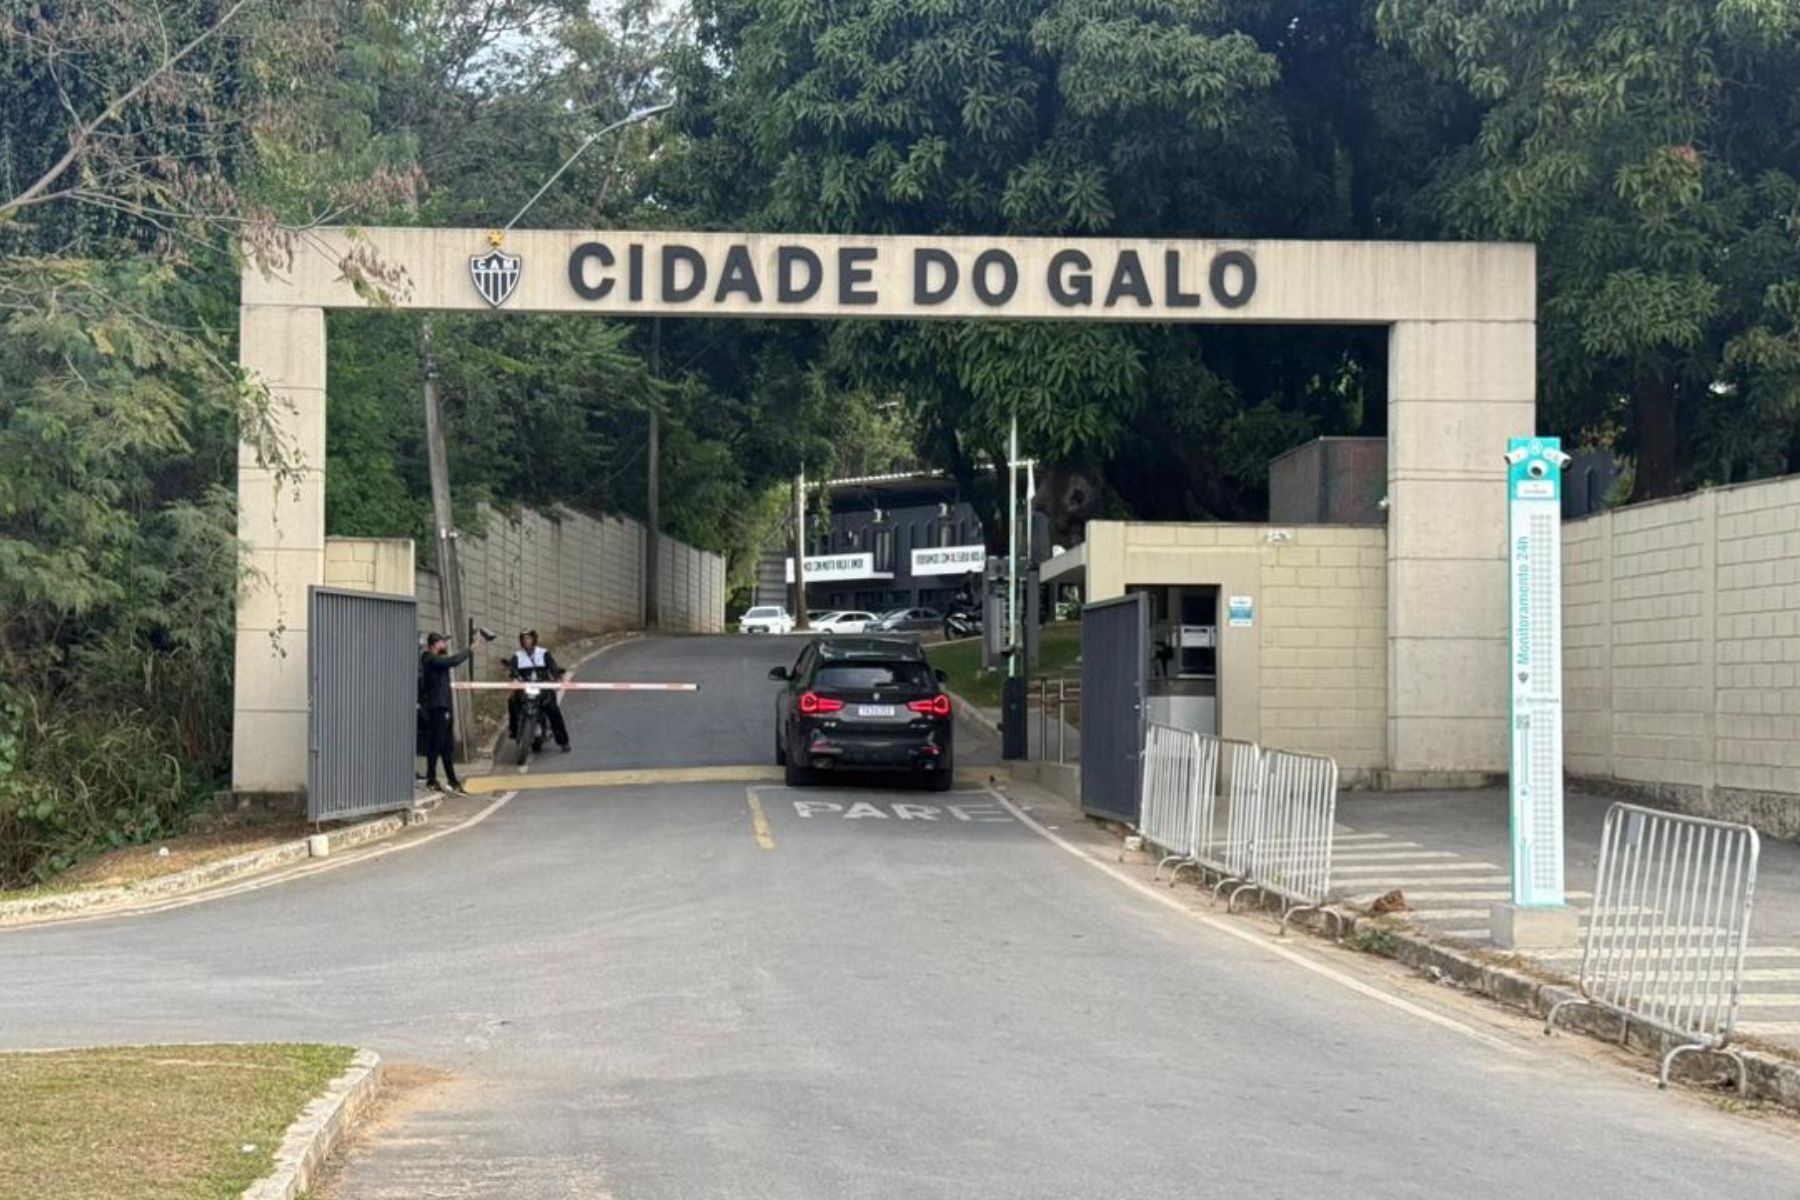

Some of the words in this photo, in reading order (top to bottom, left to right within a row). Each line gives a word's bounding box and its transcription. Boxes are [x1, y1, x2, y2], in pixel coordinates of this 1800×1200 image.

[477, 259, 514, 270] CAM
[568, 242, 878, 305] CIDADE
[913, 248, 1018, 307] DO
[1047, 248, 1257, 309] GALO
[1517, 536, 1529, 560] 24h
[1517, 564, 1530, 665] Monitoramento
[793, 801, 1014, 822] PARE
